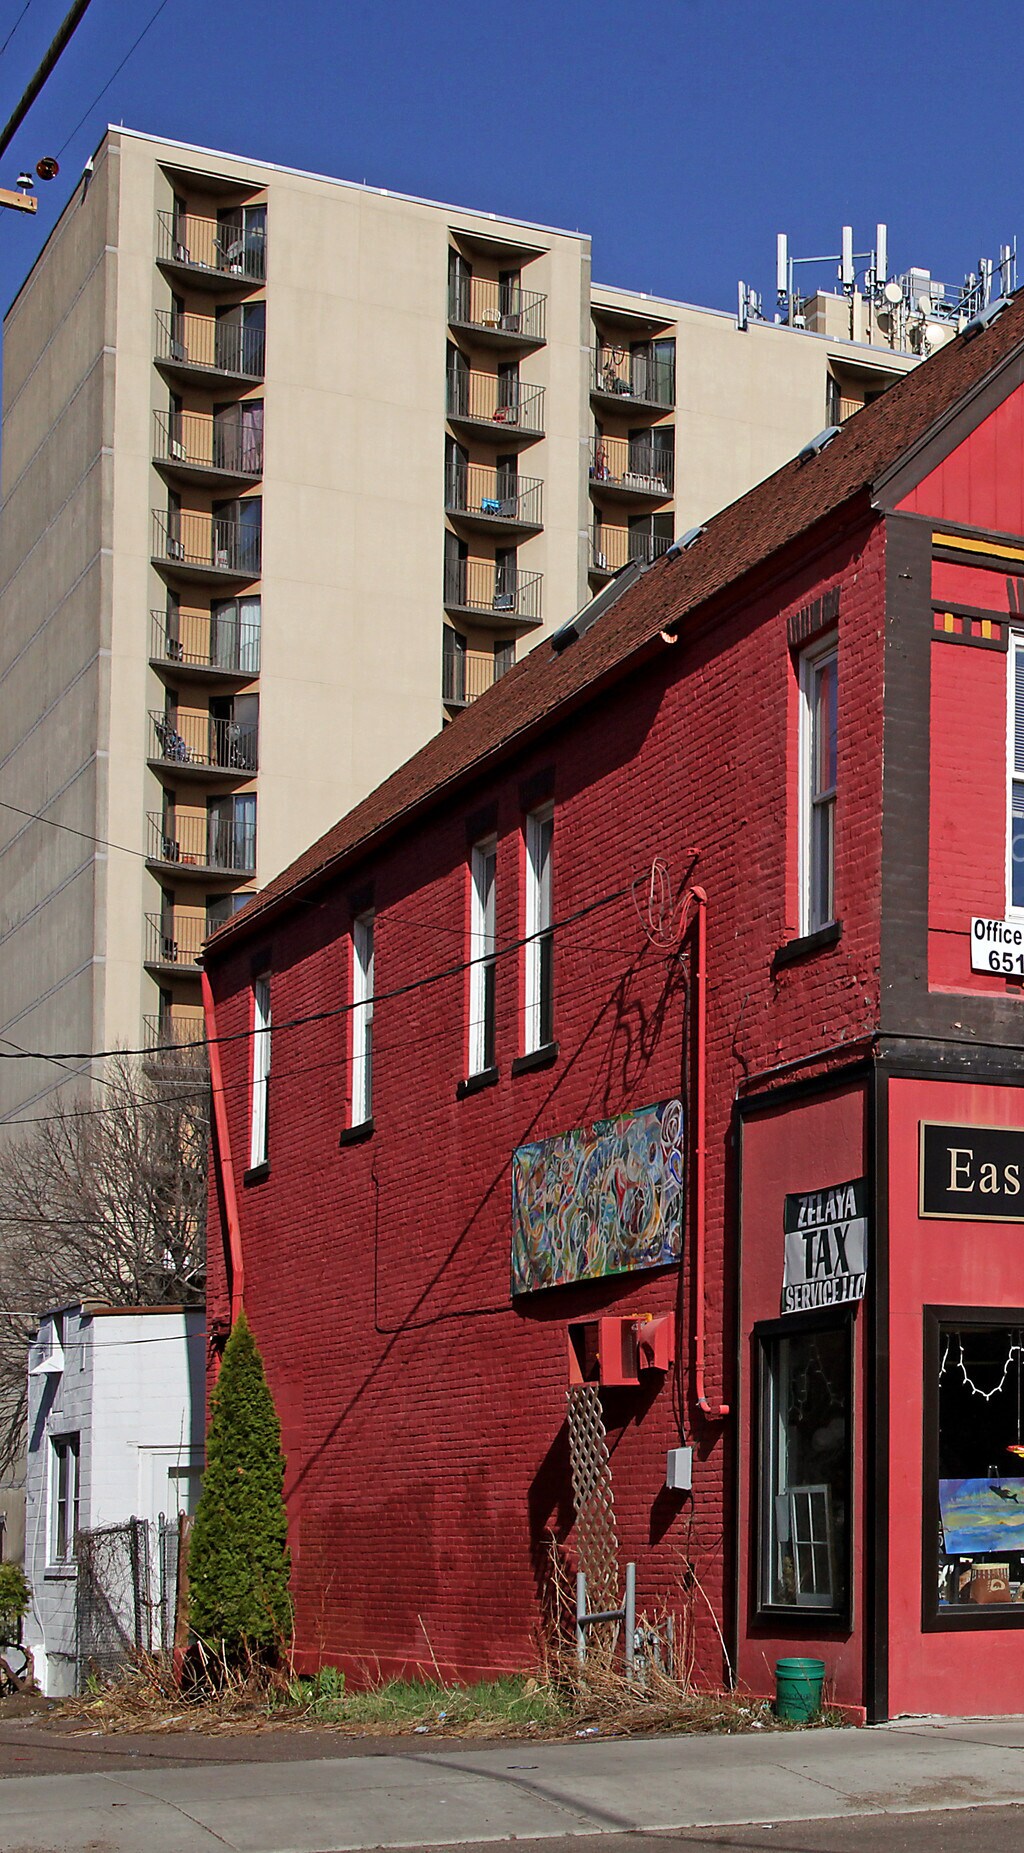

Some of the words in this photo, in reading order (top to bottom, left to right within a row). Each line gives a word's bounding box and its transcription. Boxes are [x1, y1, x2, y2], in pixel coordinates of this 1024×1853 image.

[974, 919, 1022, 945] Office
[798, 1185, 857, 1229] ZELAYA
[802, 1223, 850, 1280] TAX
[786, 1279, 839, 1312] SERVICE
[841, 1274, 865, 1301] LLC
